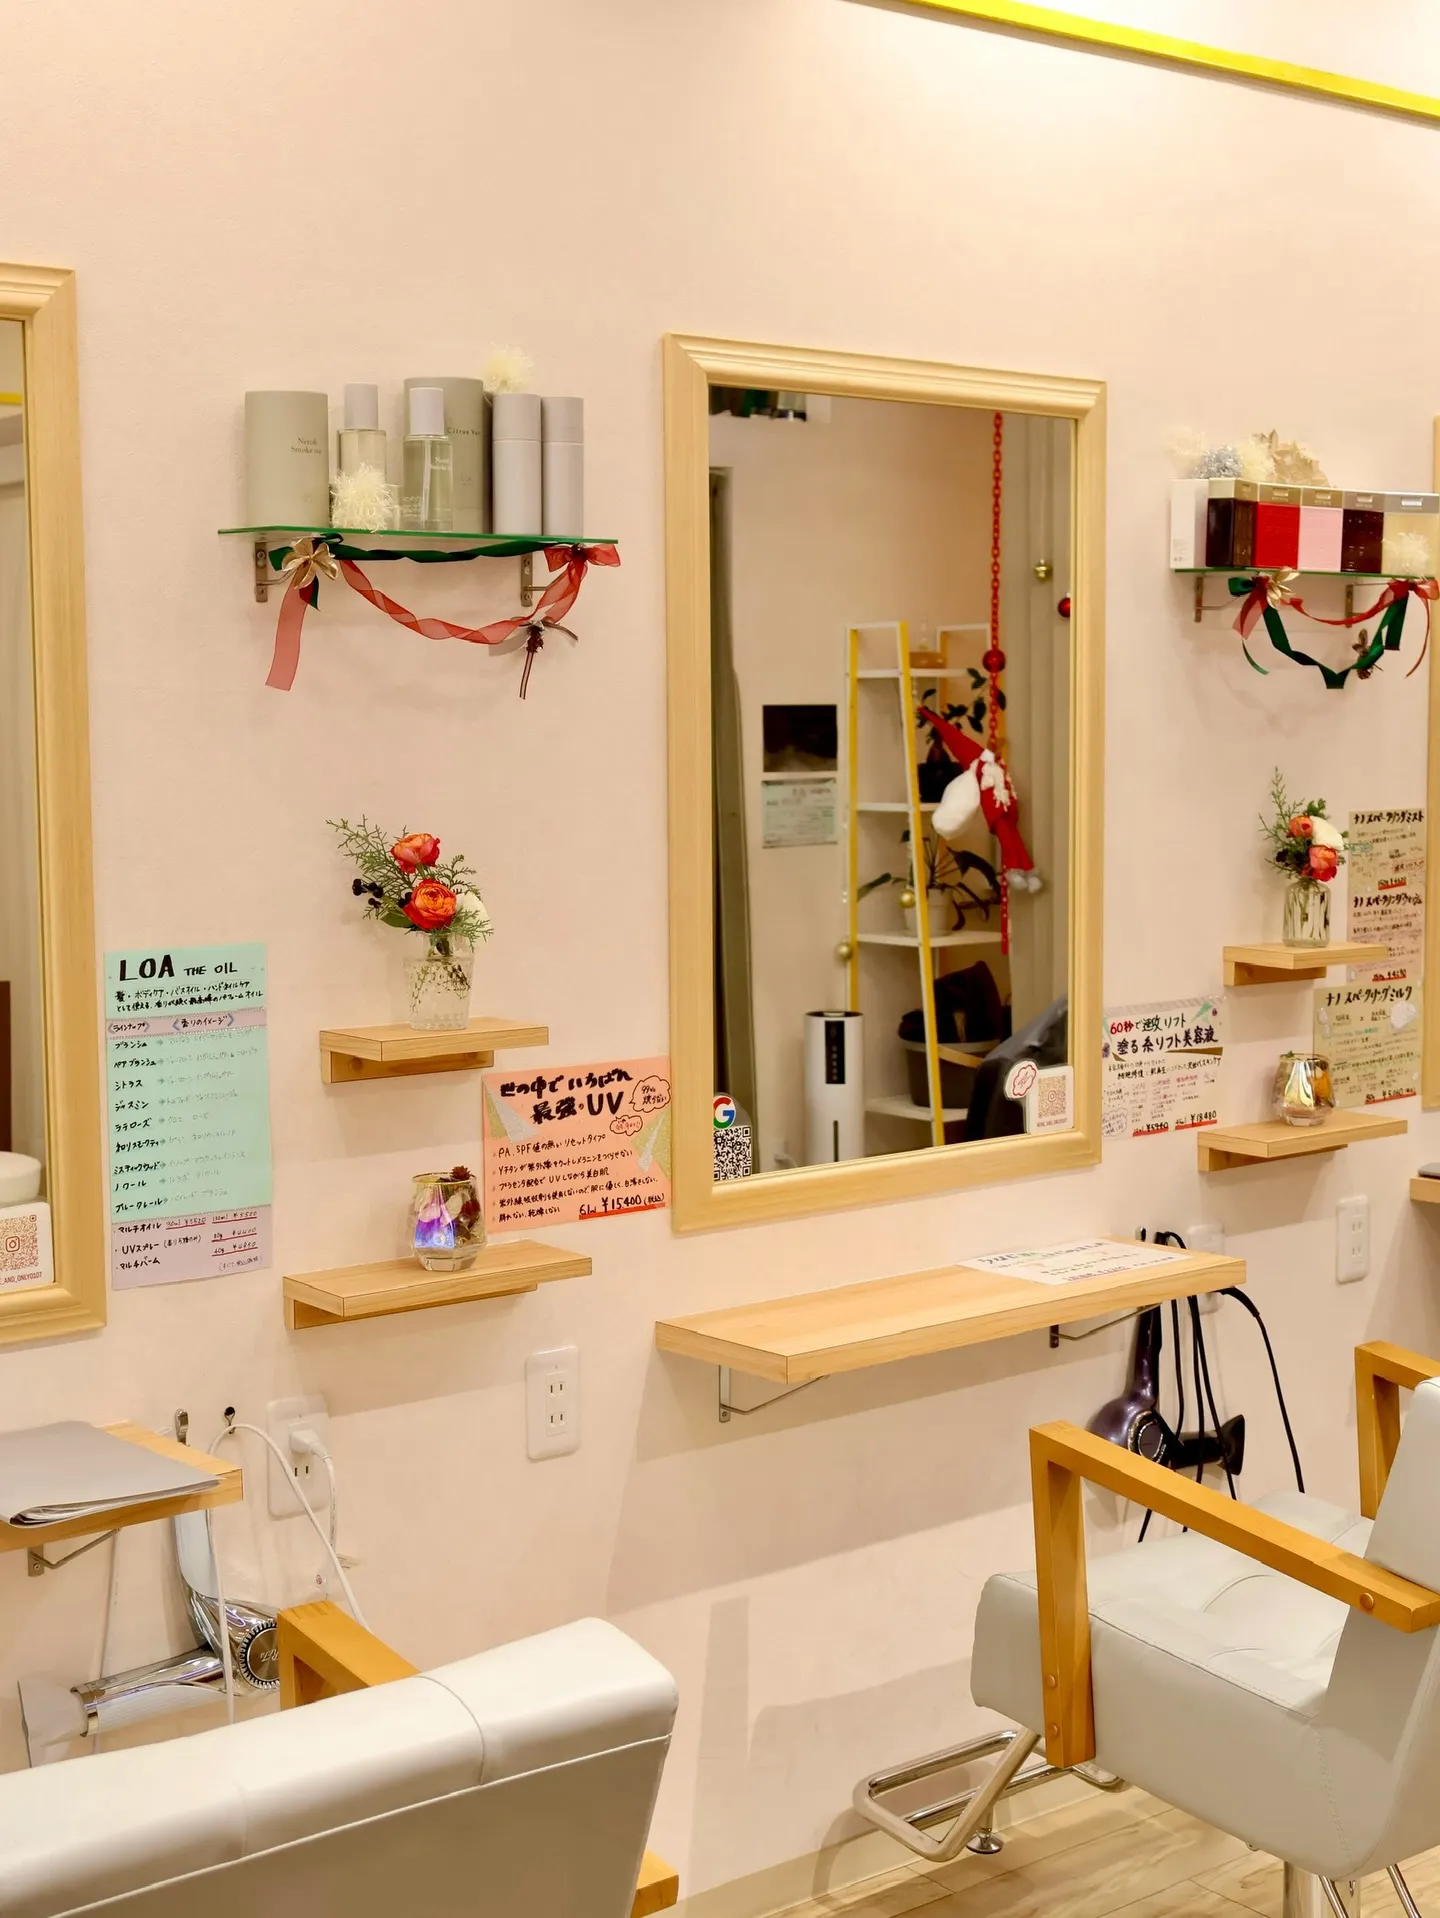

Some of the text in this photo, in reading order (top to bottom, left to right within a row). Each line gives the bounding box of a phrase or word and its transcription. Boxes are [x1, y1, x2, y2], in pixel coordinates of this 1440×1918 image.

[119, 954, 238, 981] LOA THE OIL
[115, 1080, 143, 1091] シトラス
[115, 1100, 149, 1112] ジャスミン
[114, 1181, 147, 1191] ノワール
[118, 1223, 162, 1233] マルチオイル
[119, 1257, 161, 1270] マルチバーム
[0, 1271, 42, 1286] _AND_ONLY0107
